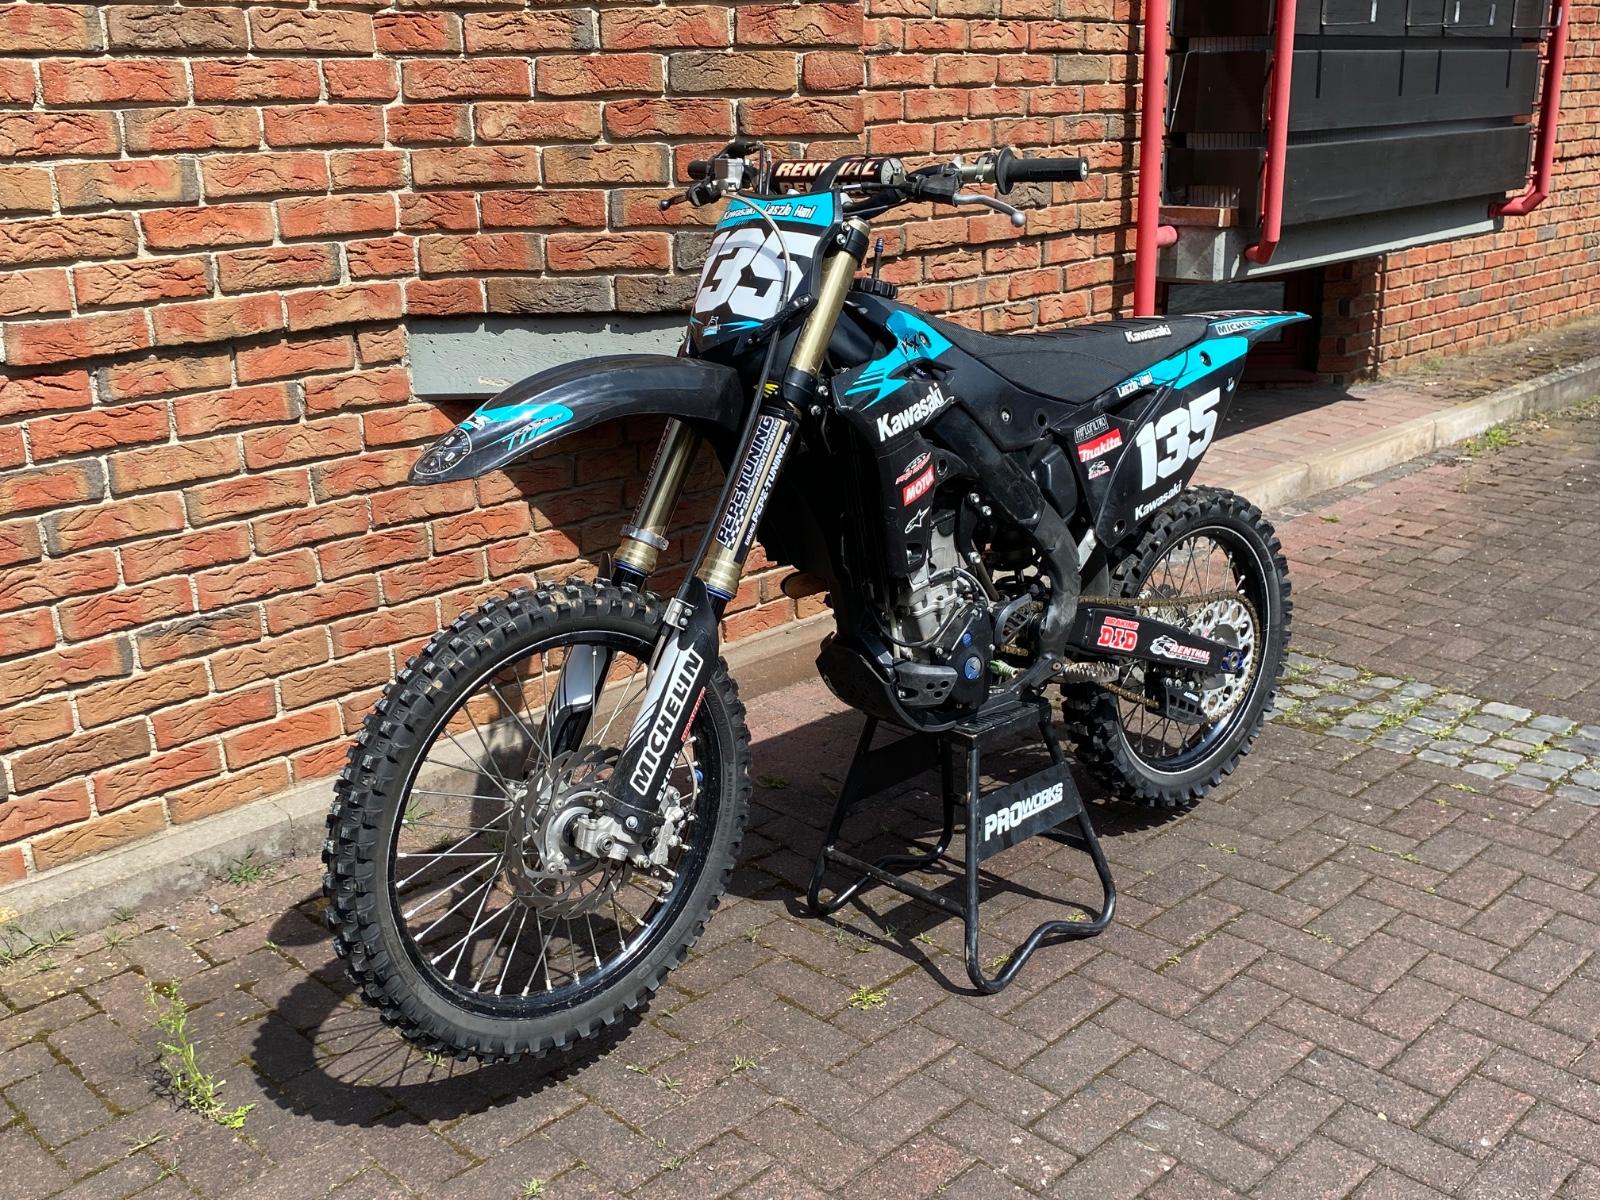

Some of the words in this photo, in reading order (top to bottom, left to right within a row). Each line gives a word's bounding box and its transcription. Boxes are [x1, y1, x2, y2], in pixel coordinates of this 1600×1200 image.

[1124, 324, 1172, 343] Kawasaki
[876, 382, 945, 442] Kawasaki
[1135, 386, 1221, 491] 135
[1134, 479, 1183, 521] Kawasaki
[1097, 625, 1138, 651] DID
[1169, 643, 1211, 661] RENTHAL
[632, 651, 702, 793] MICHELIN
[984, 782, 1064, 842] PROWORKS
